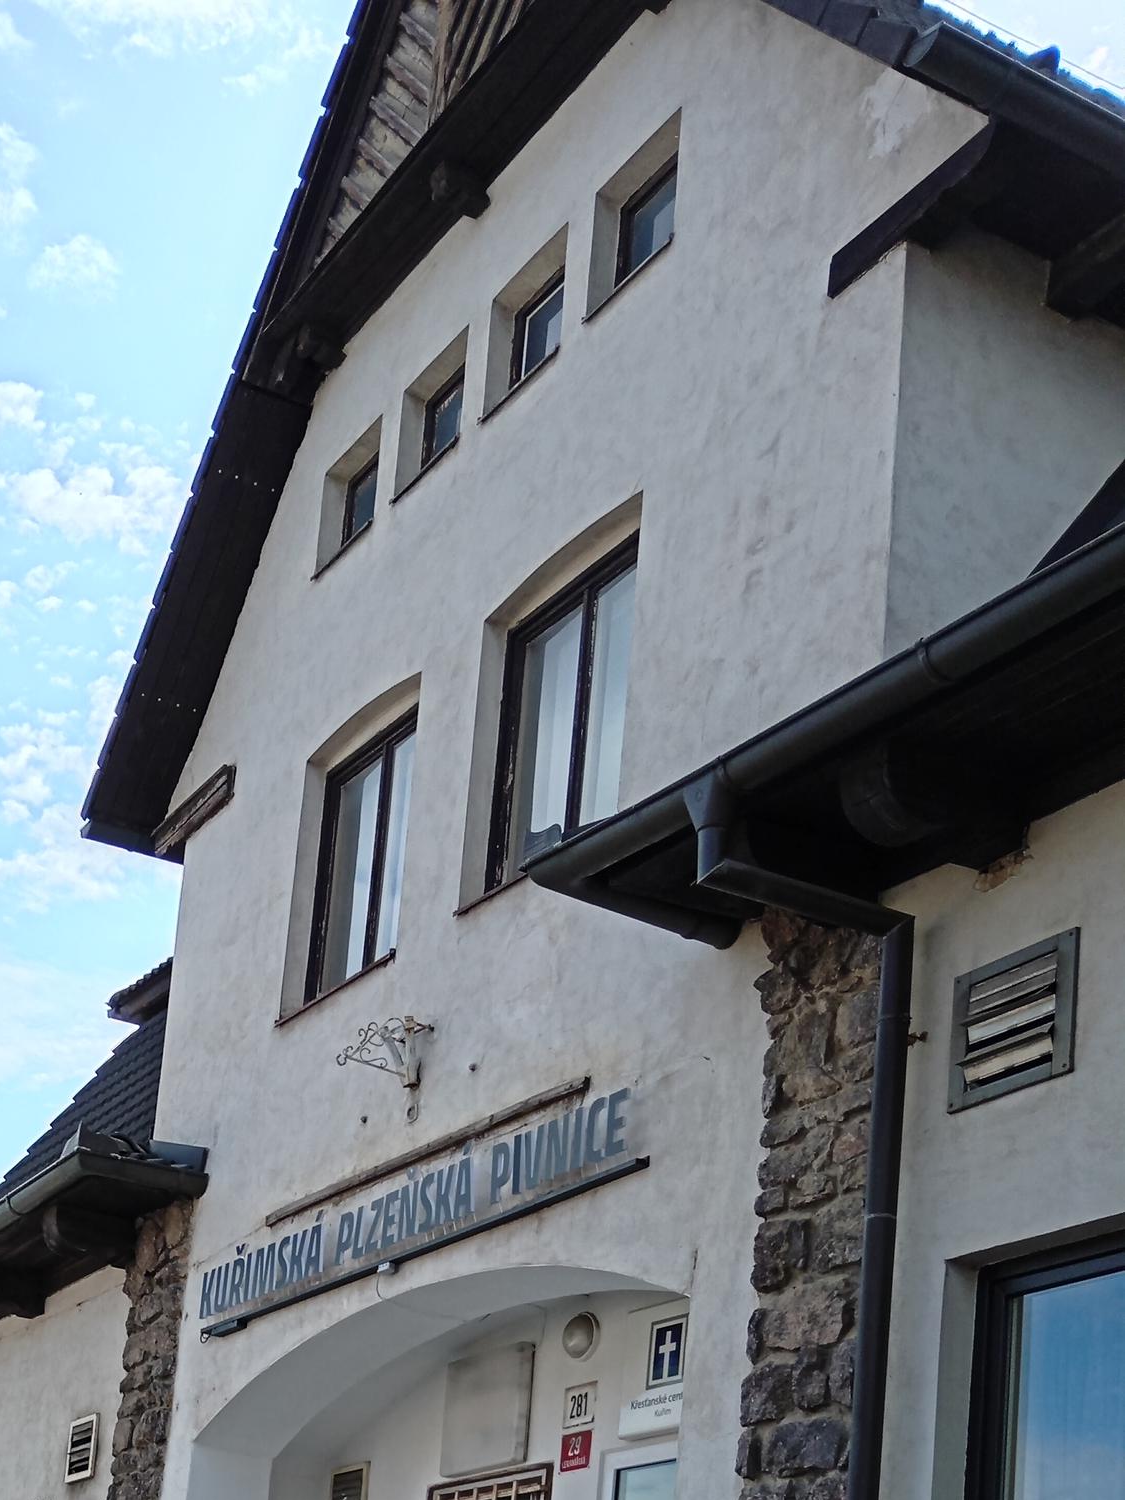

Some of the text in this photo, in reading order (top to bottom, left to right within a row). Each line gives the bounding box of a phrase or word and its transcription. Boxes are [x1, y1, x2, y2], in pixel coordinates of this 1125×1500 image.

[199, 1087, 632, 1320] KUŘIMSKÁ PLZEŇSKÁ PIVNICE
[569, 1391, 588, 1420] 281
[567, 1436, 582, 1456] 29
